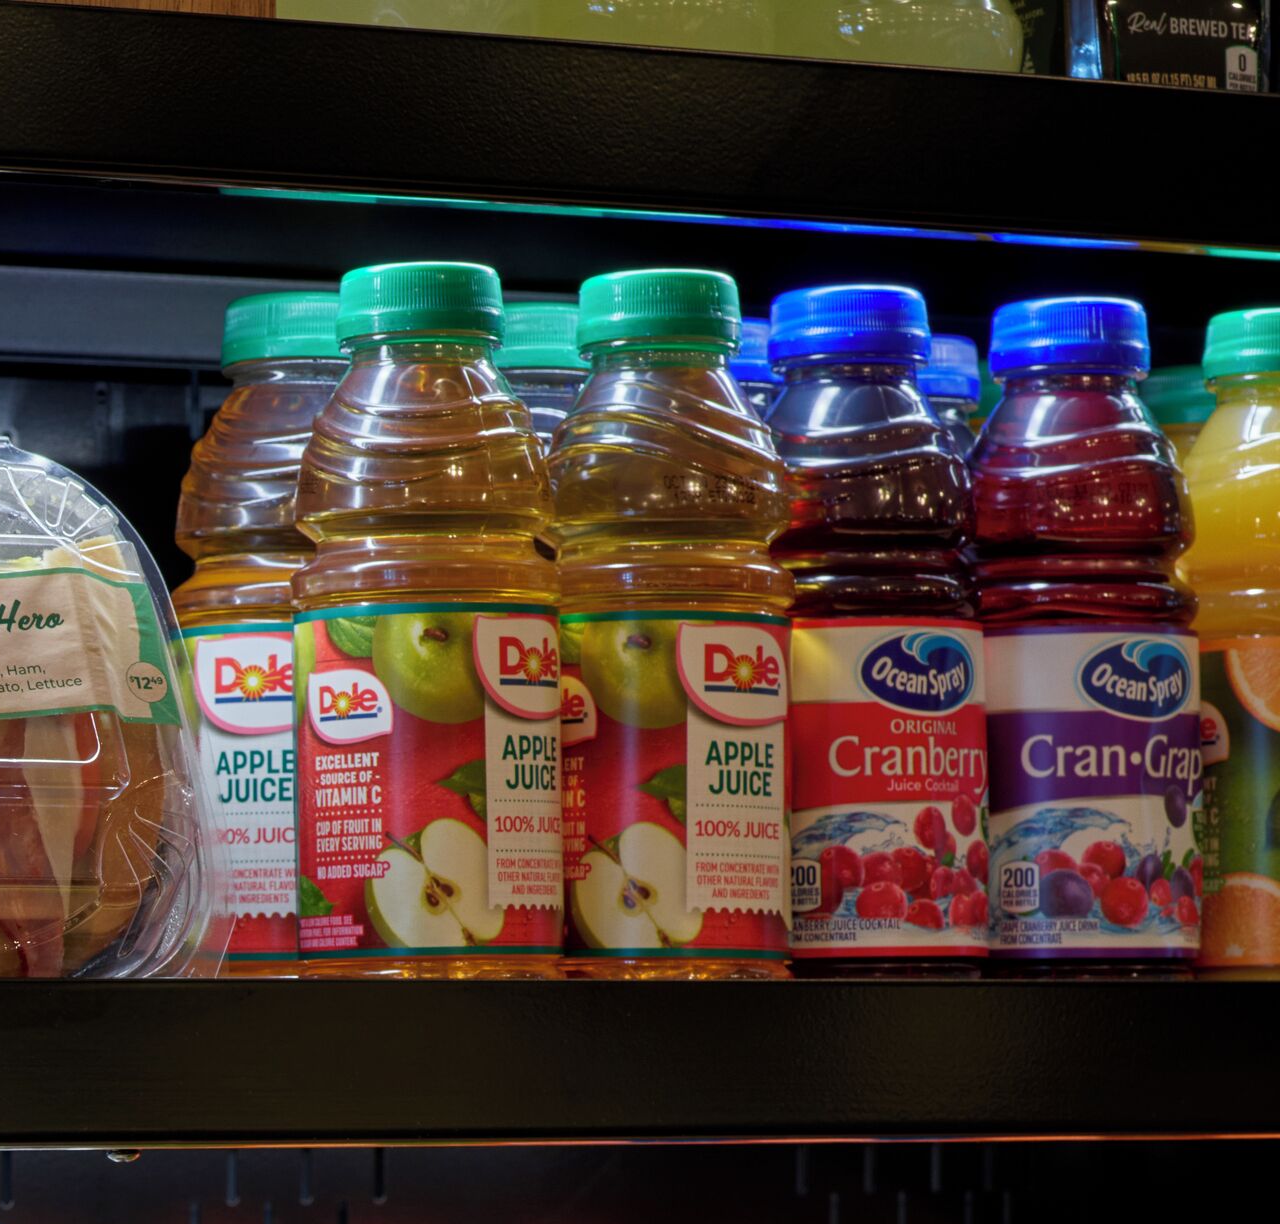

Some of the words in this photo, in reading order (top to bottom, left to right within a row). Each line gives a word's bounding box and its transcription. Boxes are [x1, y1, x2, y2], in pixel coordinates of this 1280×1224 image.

[1128, 12, 1167, 35] Real
[1170, 17, 1228, 37] BREWED
[7, 664, 46, 677] Ham,
[499, 636, 558, 682] Dole
[704, 643, 780, 690] Dole
[28, 676, 83, 691] Lettuce
[872, 656, 927, 695] Ocean
[928, 661, 966, 700] Spray
[1091, 663, 1147, 702] Ocean
[1149, 669, 1183, 707] Spray
[319, 682, 379, 717] Dole
[890, 718, 957, 735] ORIGINAL
[502, 735, 557, 762] APPLE
[705, 740, 774, 768] APPLE
[315, 752, 380, 772] EXCELLENT
[828, 735, 988, 794] Cranberry
[320, 773, 357, 786] SOURCE
[359, 770, 373, 784] OF
[505, 763, 556, 791] JUICE
[709, 769, 772, 797] JUICE
[887, 778, 921, 792] Juice
[925, 778, 959, 792] Cocktail
[219, 777, 293, 804] JUICE
[315, 786, 367, 808] VITAMIN
[371, 784, 382, 805] C
[495, 815, 534, 833] 100%
[695, 820, 740, 838] 100%
[744, 822, 779, 840] JUICE
[342, 834, 383, 851] SERVING
[1003, 867, 1035, 888] 200
